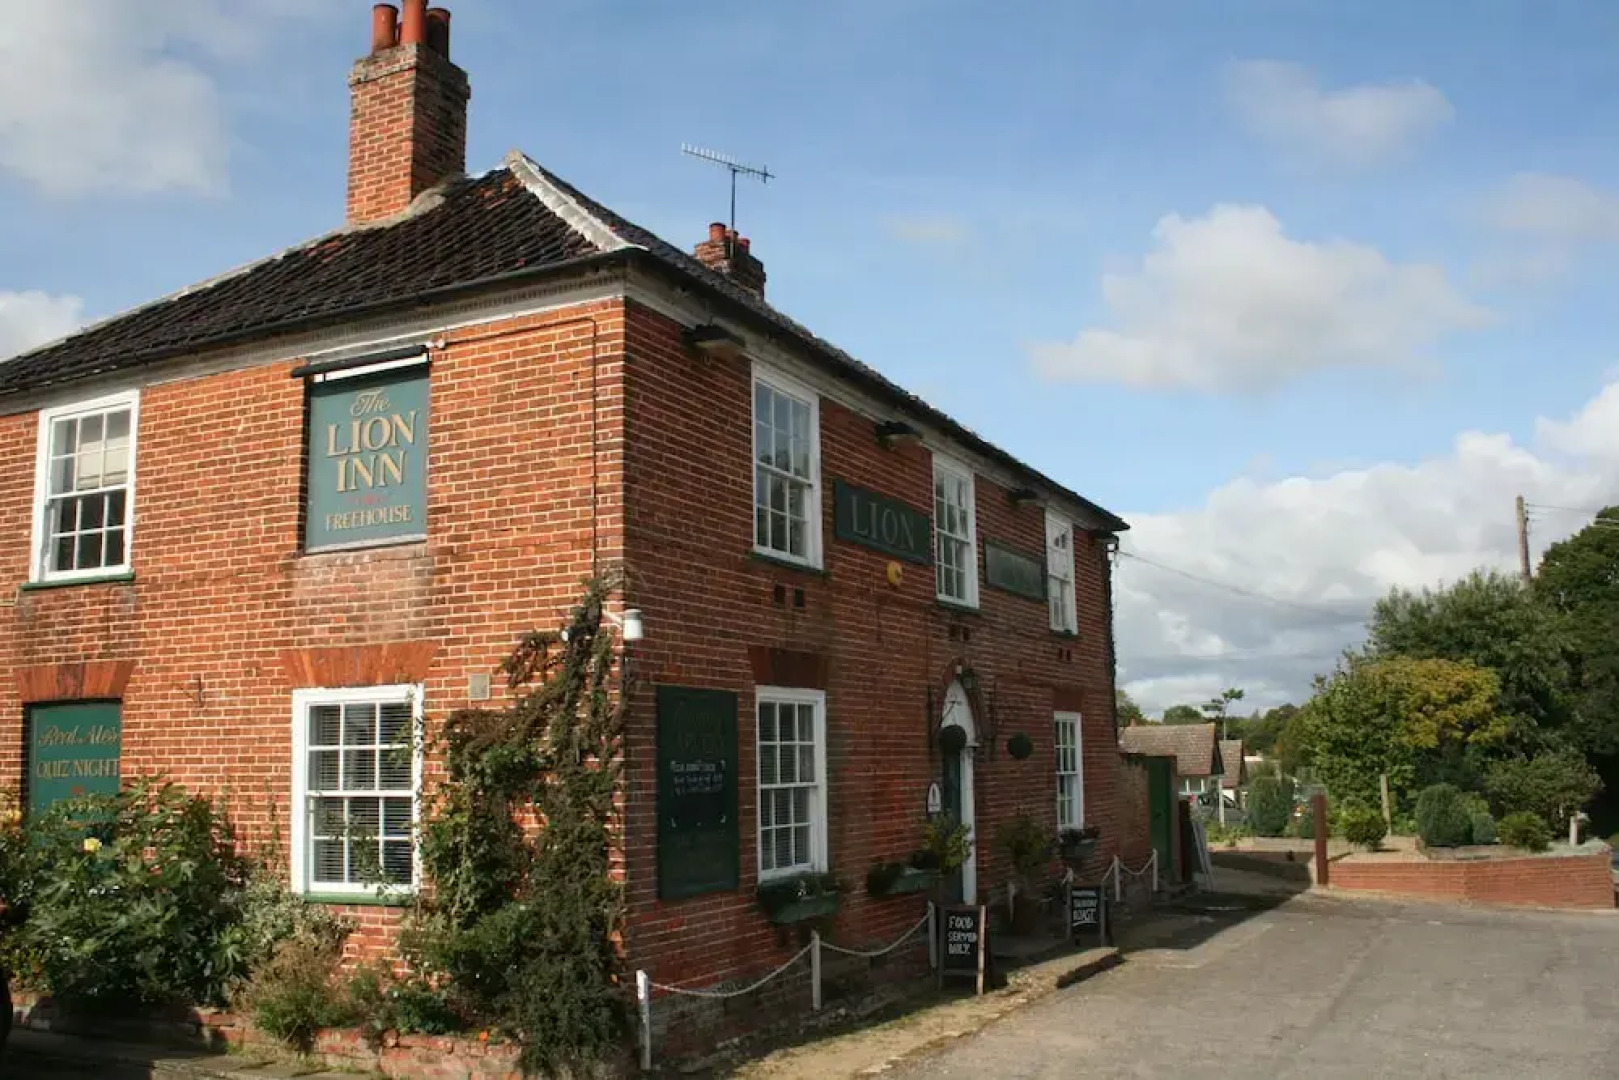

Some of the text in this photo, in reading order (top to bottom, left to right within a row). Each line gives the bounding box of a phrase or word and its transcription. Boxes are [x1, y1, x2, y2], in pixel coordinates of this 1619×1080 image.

[350, 388, 390, 416] The
[326, 410, 416, 458] LION
[336, 451, 406, 492] INN
[325, 505, 412, 531] FREEHOUSE
[850, 494, 916, 551] LION
[37, 759, 119, 779] QUIZ NIGHT
